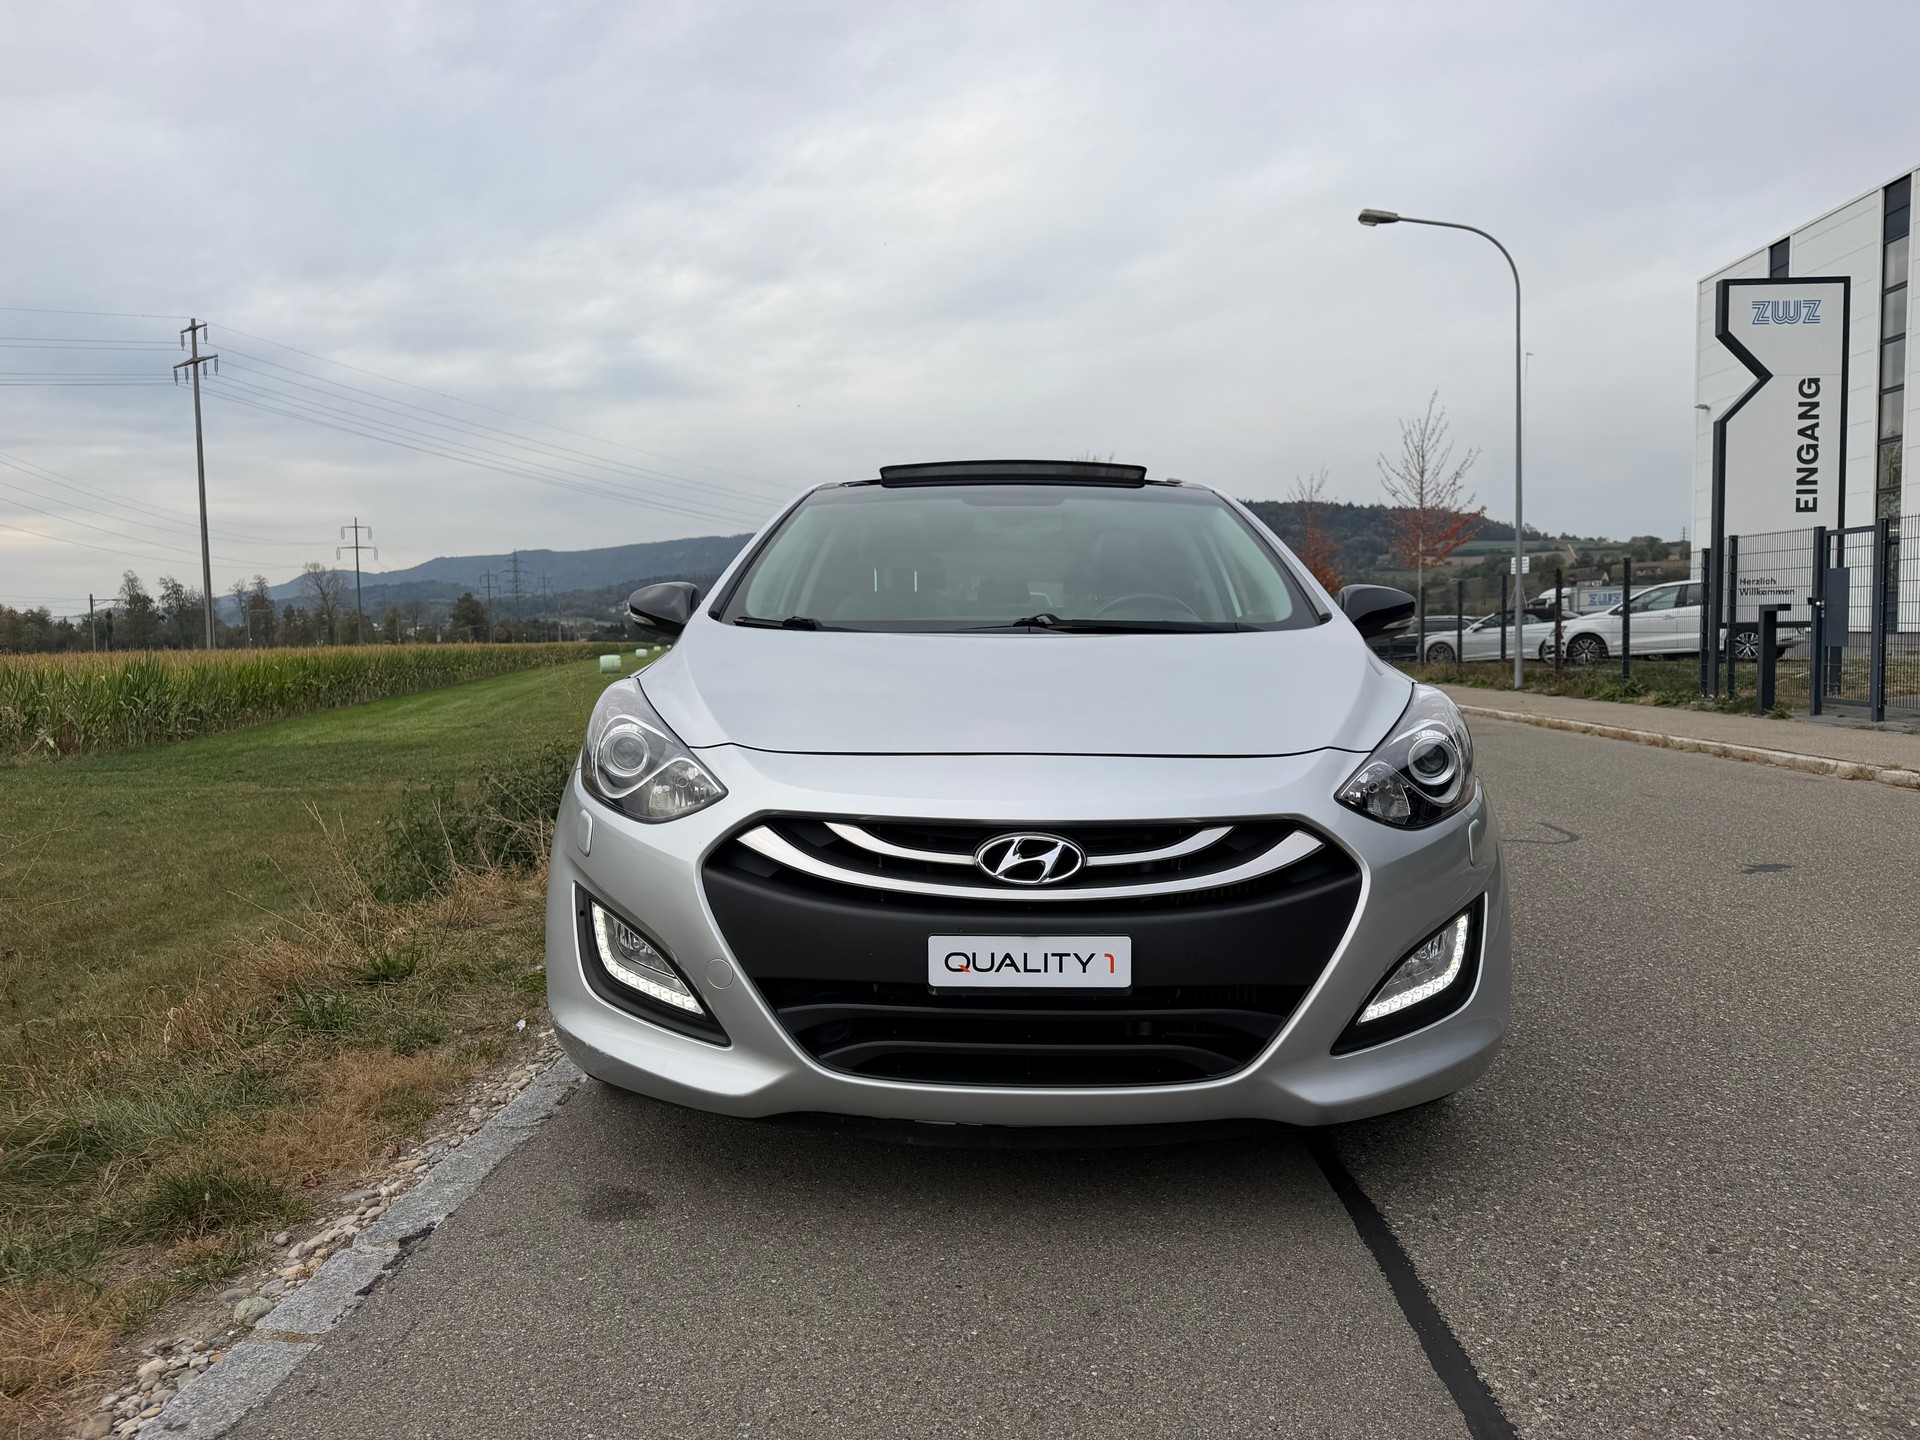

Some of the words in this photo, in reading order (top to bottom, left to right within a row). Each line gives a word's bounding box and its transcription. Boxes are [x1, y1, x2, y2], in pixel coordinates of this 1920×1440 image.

[1752, 300, 1821, 325] ZWZ
[1796, 377, 1821, 513] EINGANG
[1740, 577, 1776, 585] Herzlich
[1740, 588, 1795, 596] Willkommen
[944, 952, 1096, 973] QUALITY
[1104, 953, 1115, 974] 1
